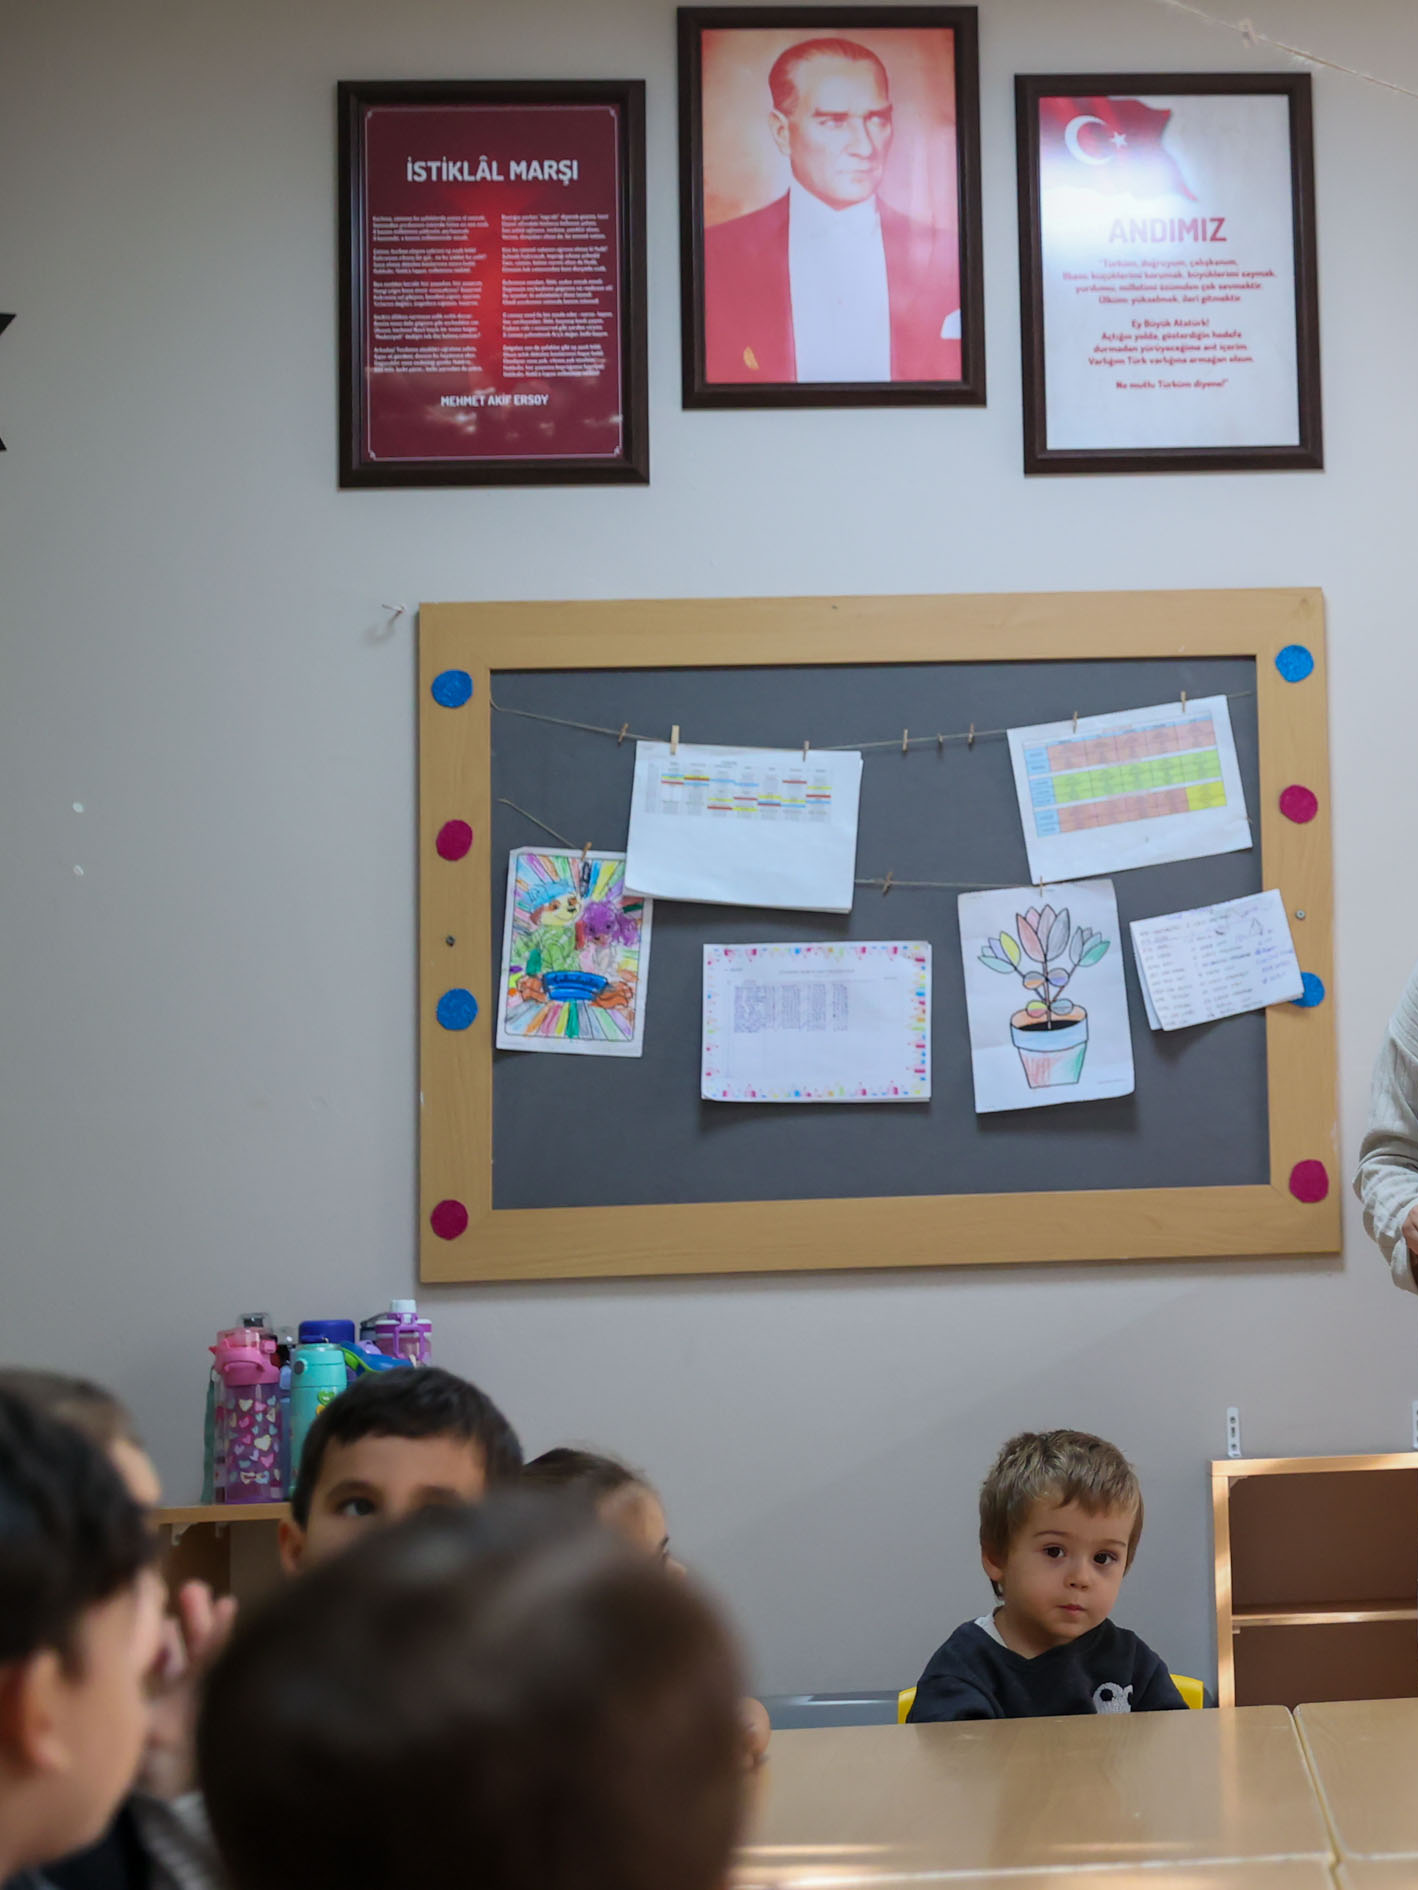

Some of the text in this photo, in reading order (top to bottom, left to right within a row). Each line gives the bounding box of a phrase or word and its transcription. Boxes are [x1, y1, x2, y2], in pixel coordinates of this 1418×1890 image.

[407, 155, 578, 186] İSTİKLÂL MARŞI
[1108, 218, 1227, 243] ANDIMIZ
[440, 393, 549, 407] MEHMET AKİF ERSOY
